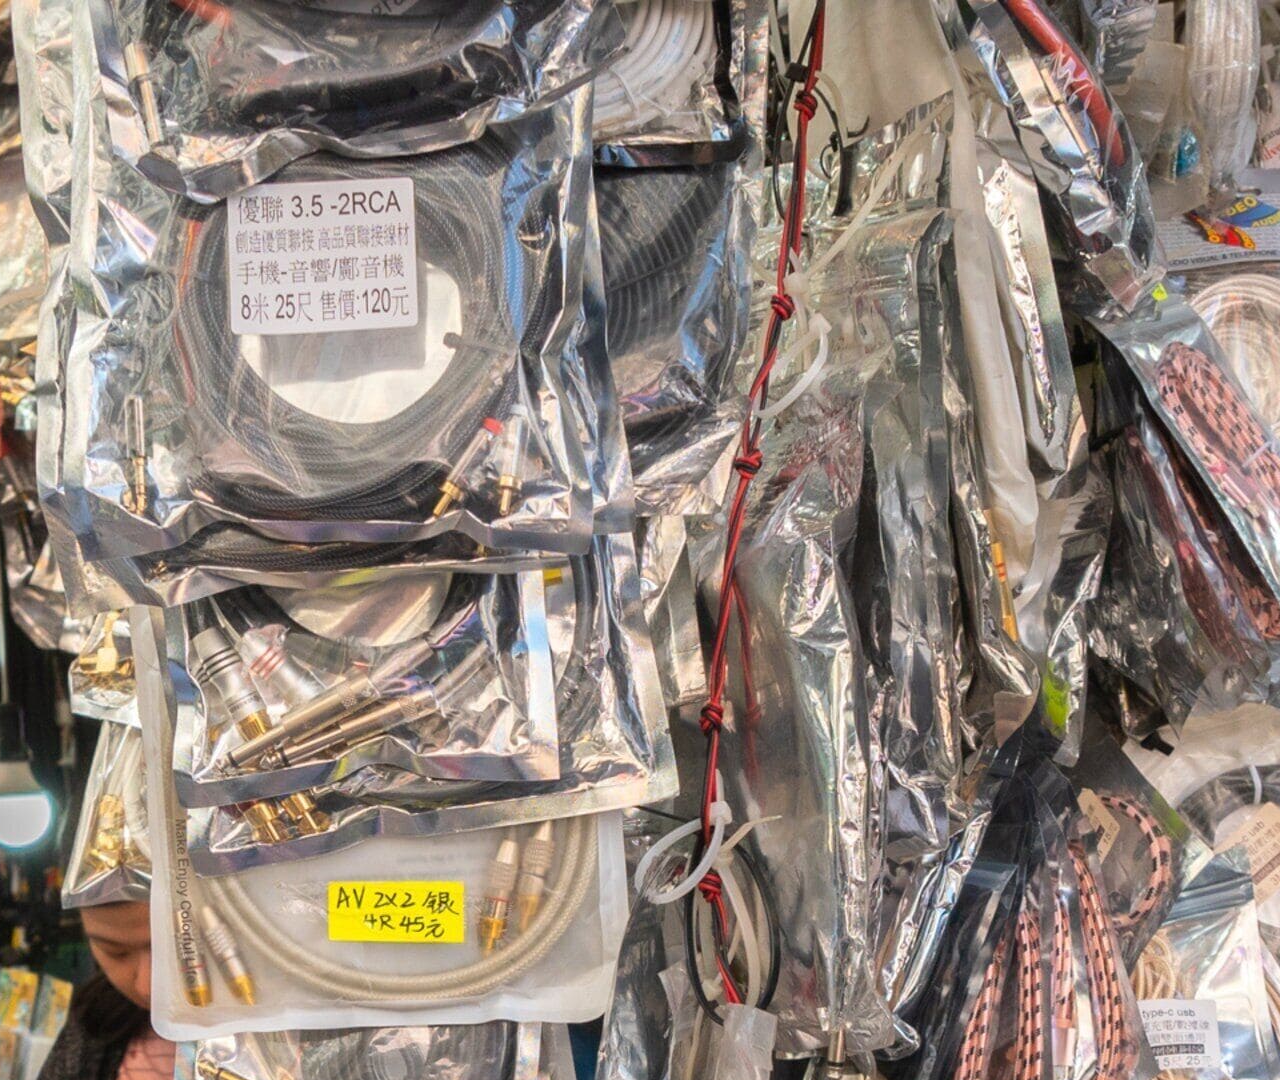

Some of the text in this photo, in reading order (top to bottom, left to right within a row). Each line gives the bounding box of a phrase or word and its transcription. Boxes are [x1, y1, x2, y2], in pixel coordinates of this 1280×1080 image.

[239, 190, 402, 224] 優聯 3.5 -2RCA
[1190, 255, 1218, 265] VISUAL
[1230, 250, 1278, 259] TELEPHONE
[241, 286, 409, 324] 8米 25尺 售價:120元
[175, 819, 188, 855] Make
[176, 858, 190, 897] Enjoy
[337, 886, 366, 909] AV
[422, 891, 459, 915] 銀
[180, 900, 196, 954] Colorful
[399, 915, 445, 938] 45元
[1142, 1008, 1196, 1020] type-c usb
